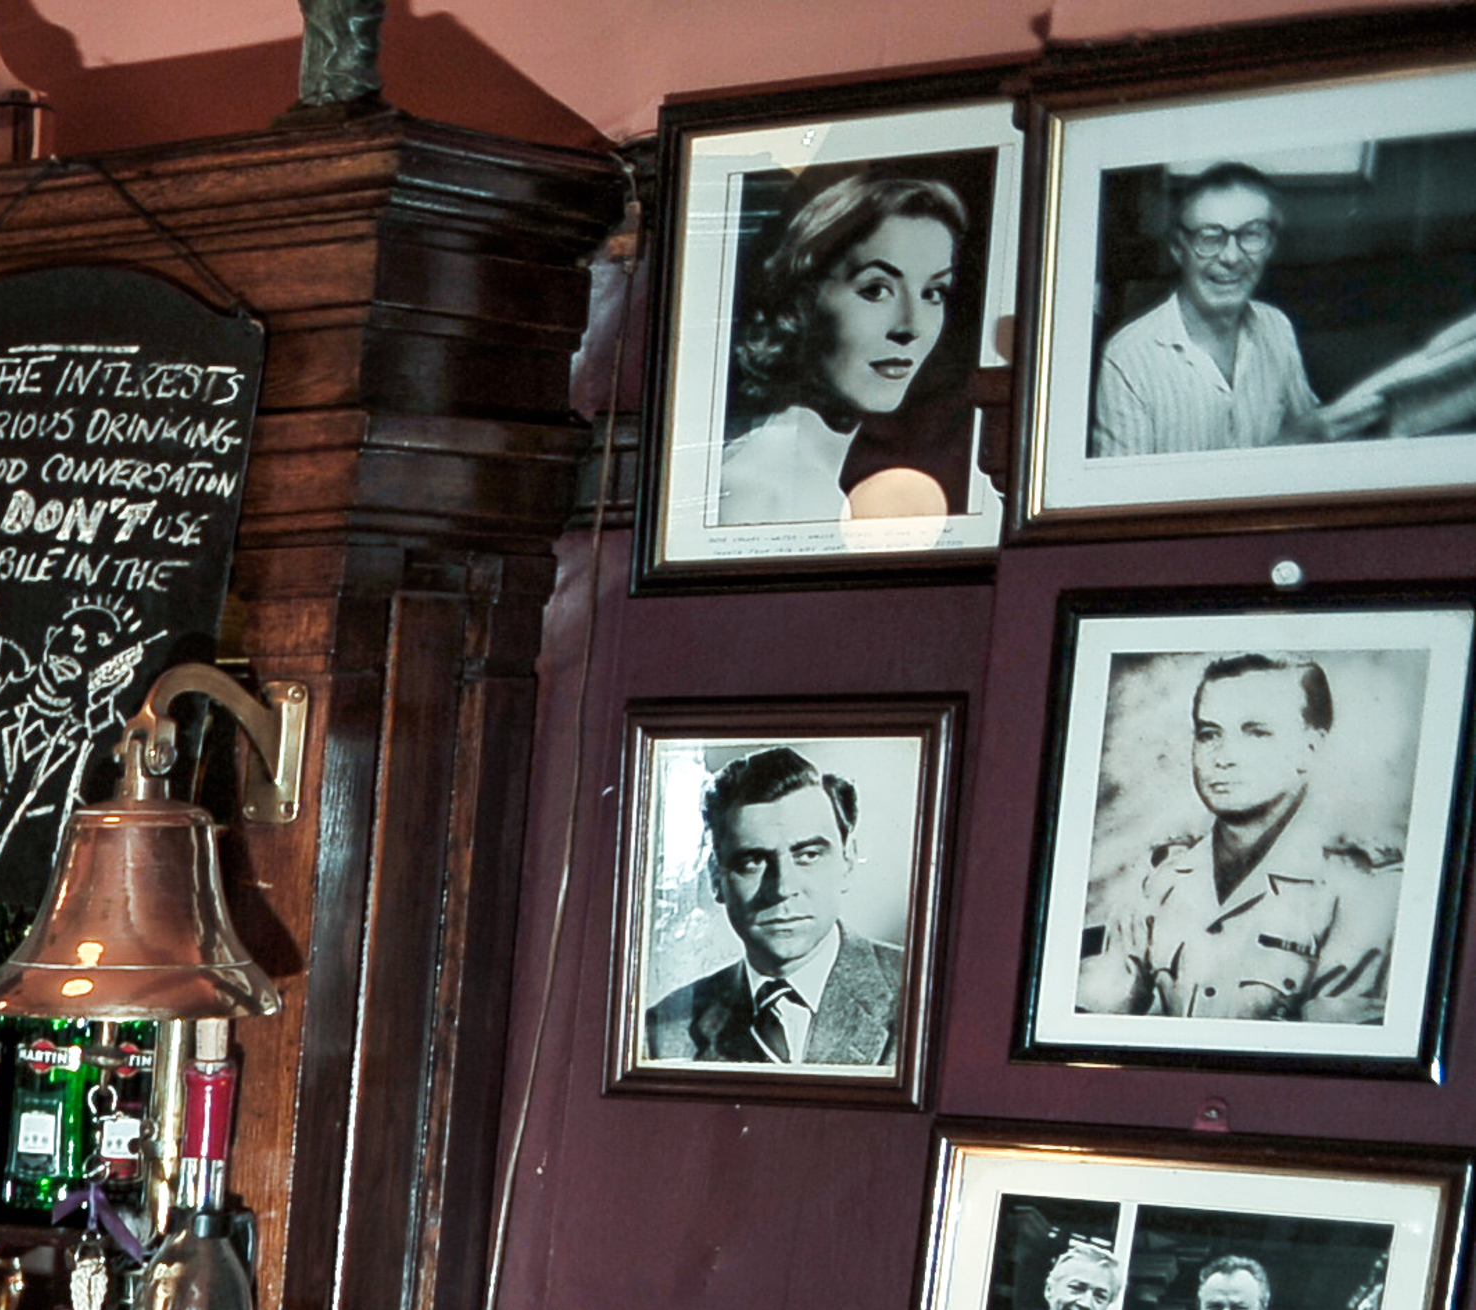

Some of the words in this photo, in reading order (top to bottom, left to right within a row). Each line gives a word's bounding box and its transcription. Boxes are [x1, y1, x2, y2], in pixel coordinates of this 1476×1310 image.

[55, 357, 245, 407] INTERESTS
[84, 407, 243, 455] DRINKING
[40, 452, 239, 499] CONVERSATION
[0, 489, 158, 544] DON'T
[152, 510, 211, 547] USE
[62, 552, 111, 586] IN
[111, 557, 192, 592] THE
